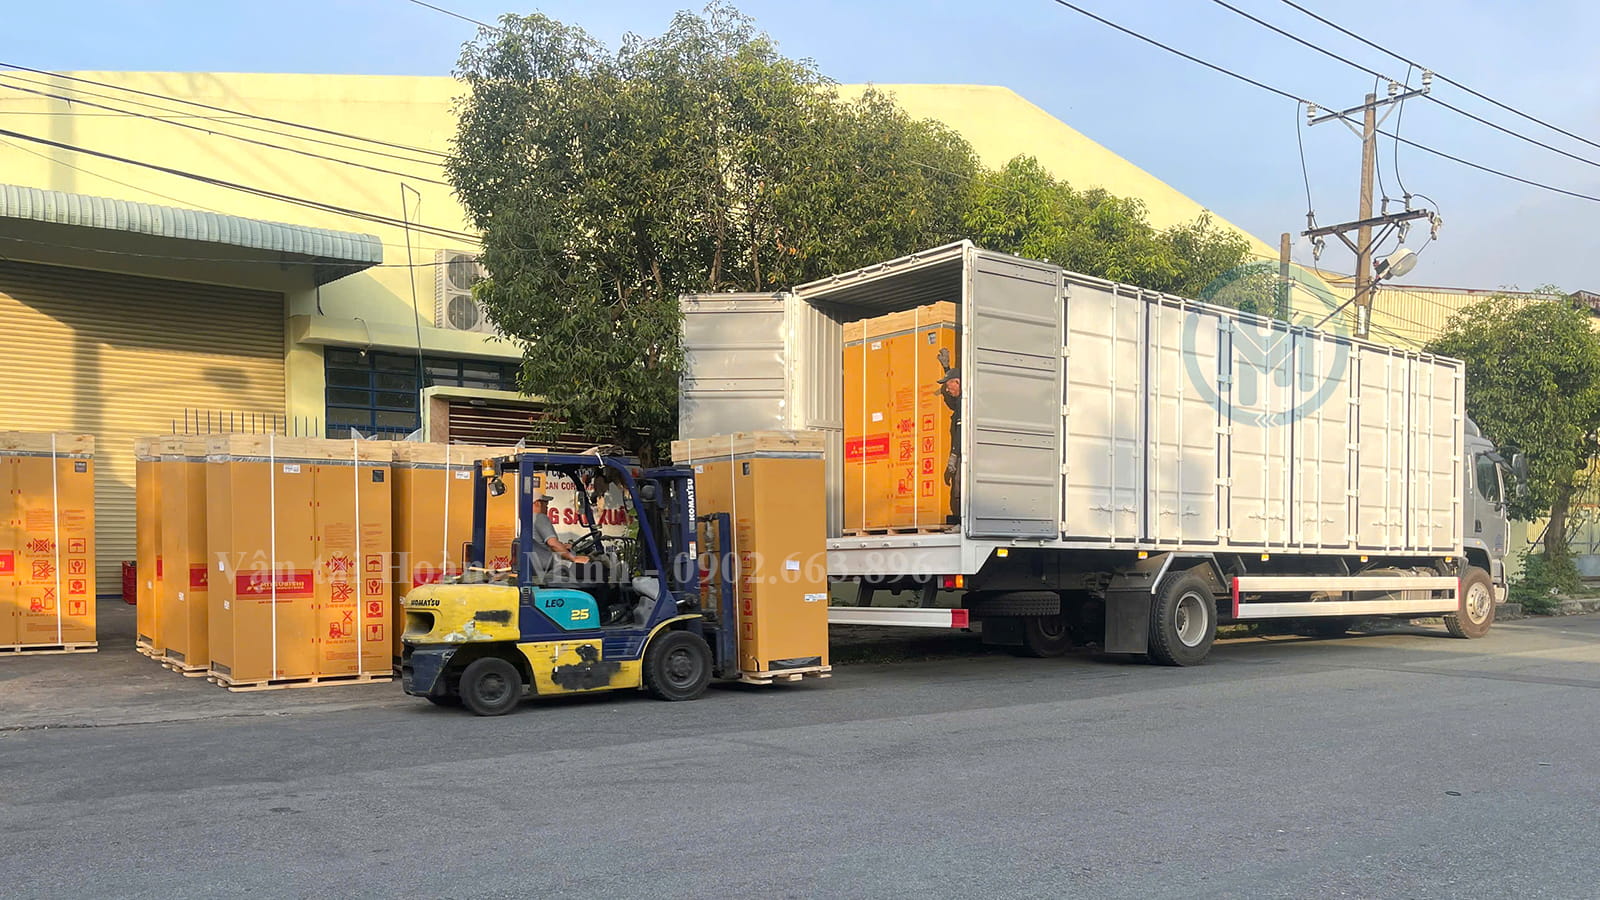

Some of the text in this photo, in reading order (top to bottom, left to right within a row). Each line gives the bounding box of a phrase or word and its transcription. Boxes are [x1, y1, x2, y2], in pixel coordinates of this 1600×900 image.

[686, 478, 696, 521] KOMATSU
[411, 598, 441, 607] KOMATSU
[545, 598, 565, 608] LEO
[570, 608, 590, 621] 25
